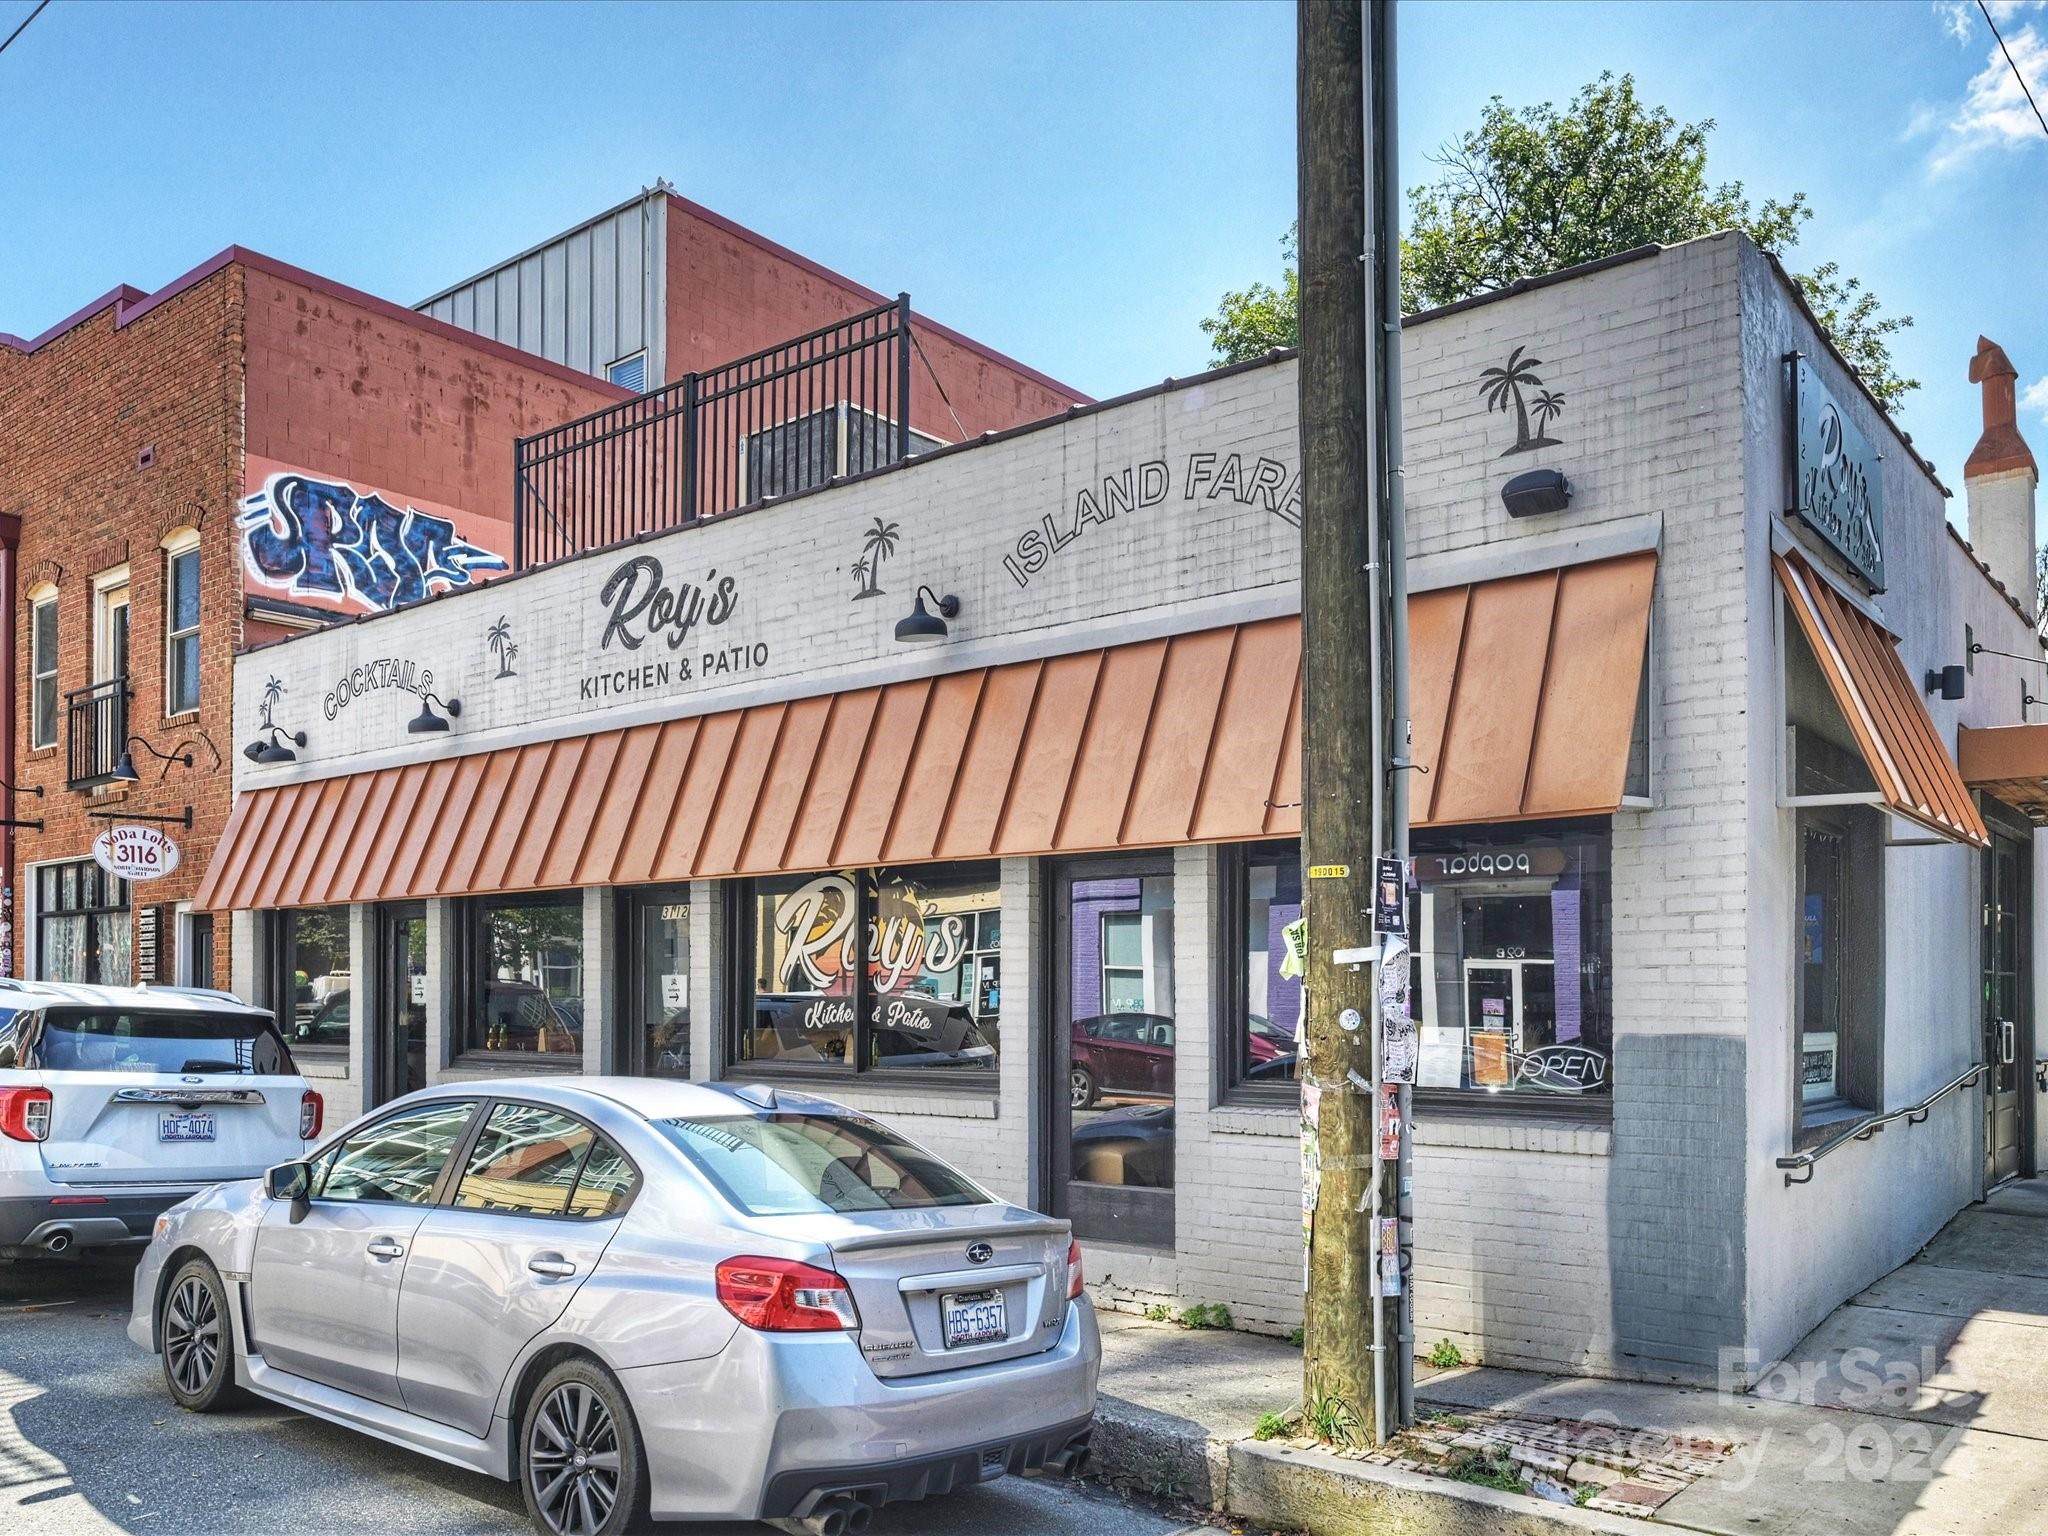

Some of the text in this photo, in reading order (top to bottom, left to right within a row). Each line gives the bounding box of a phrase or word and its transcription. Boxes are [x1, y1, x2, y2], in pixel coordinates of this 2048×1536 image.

[1002, 460, 1170, 588] ISLAND
[600, 555, 739, 651] Roy's
[580, 642, 769, 700] KITCHEN & PATIO
[323, 658, 434, 721] COCKTAILS
[100, 829, 174, 854] NoDa Lofts
[117, 844, 158, 865] 3116
[775, 873, 969, 994] Roy's
[804, 1001, 932, 1030] Kitche & Patio
[1521, 1054, 1607, 1080] OPEN
[162, 1119, 214, 1135] HDF-4074
[947, 1304, 1003, 1335] HBS-6357
